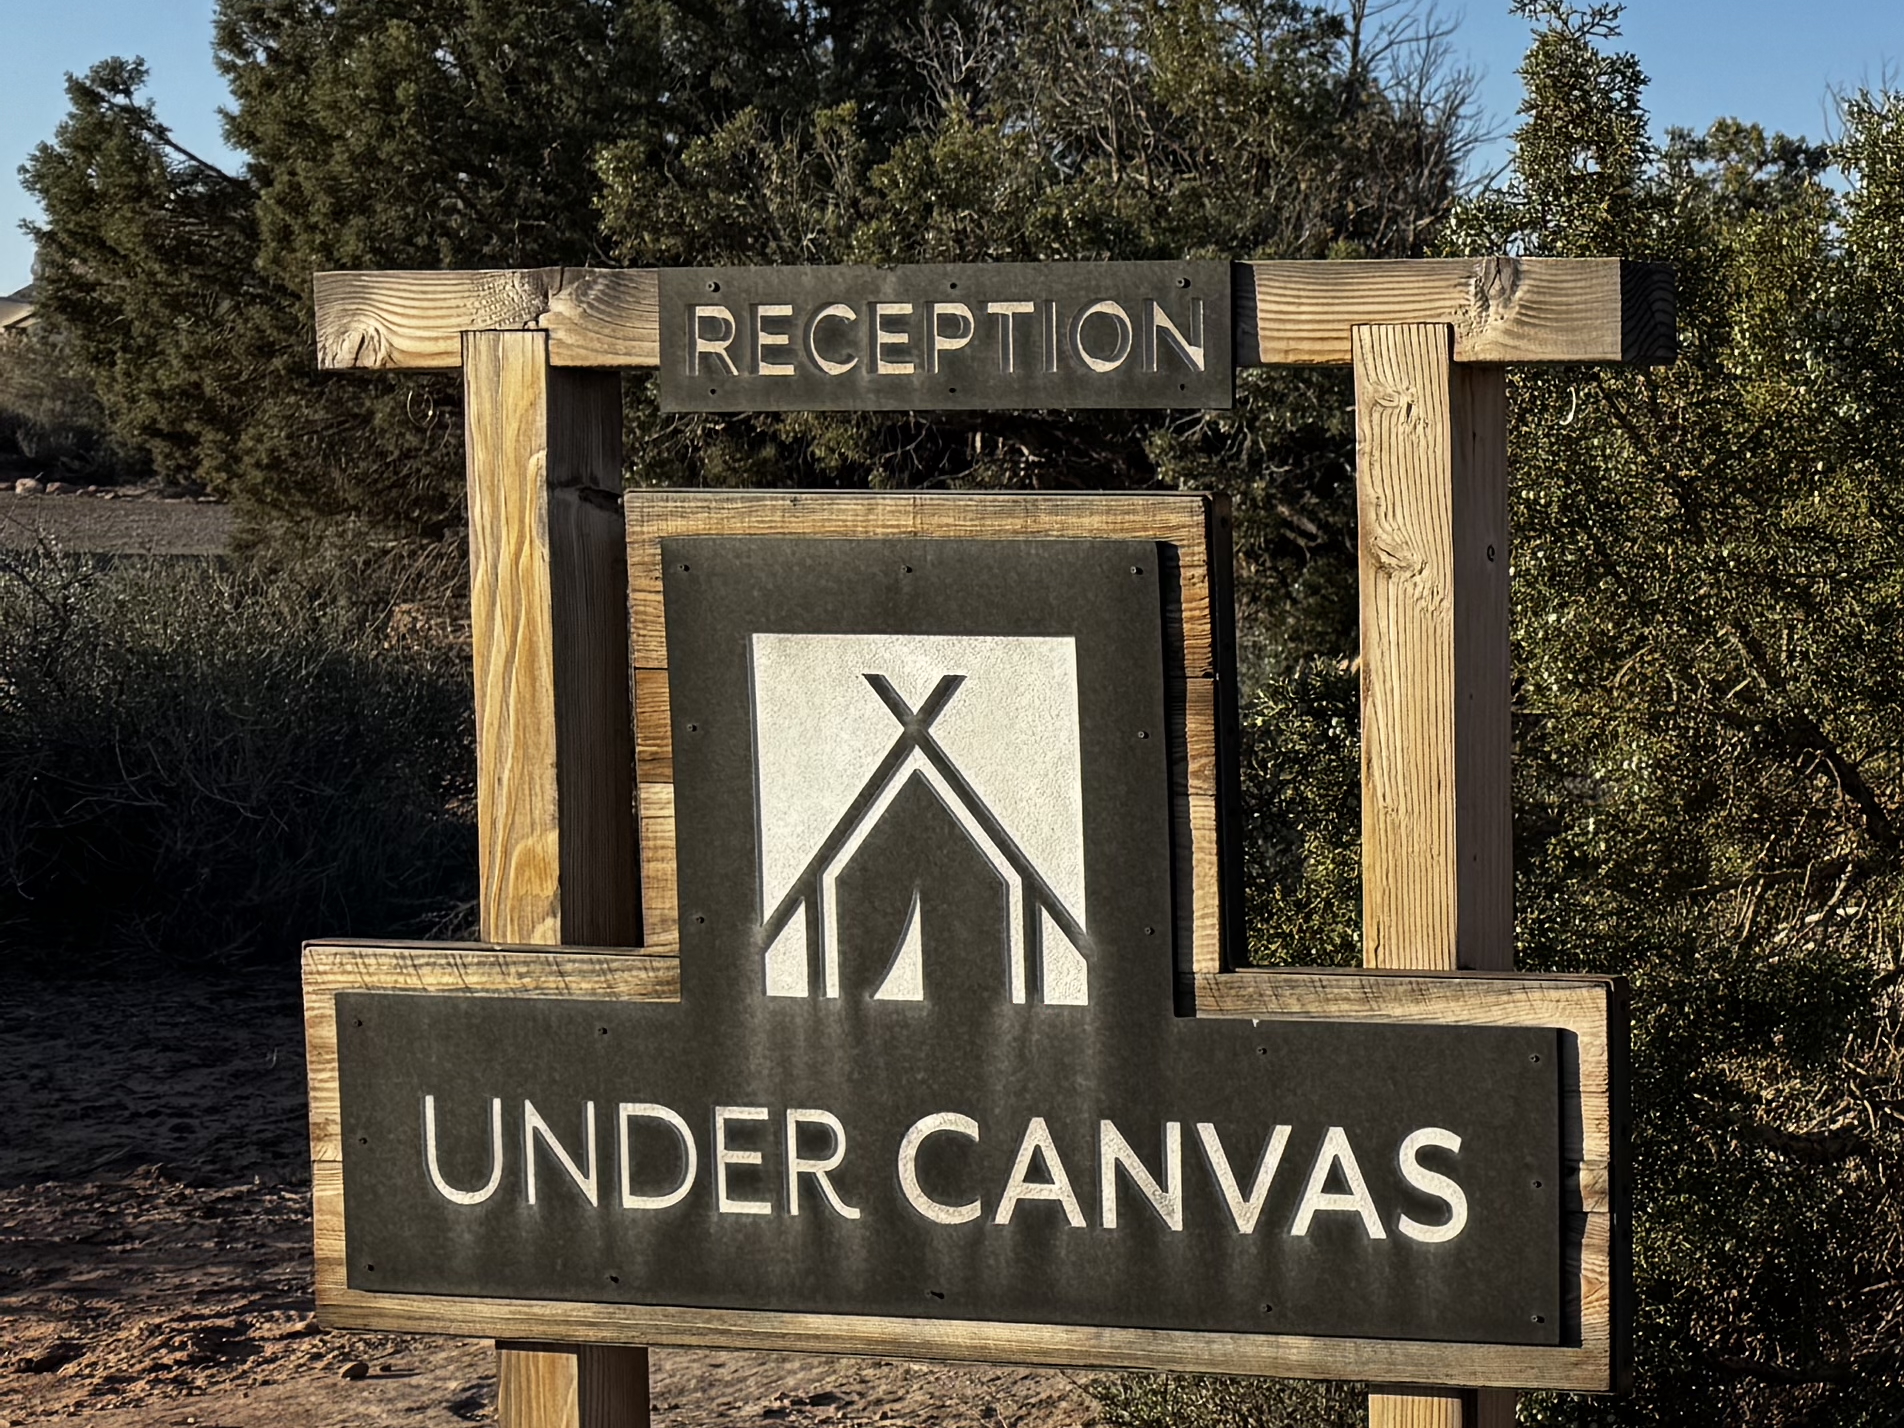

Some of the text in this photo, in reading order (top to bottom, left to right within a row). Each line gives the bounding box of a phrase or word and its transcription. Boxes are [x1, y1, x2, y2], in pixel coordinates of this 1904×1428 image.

[687, 299, 1205, 376] RECEPTION
[422, 1094, 1469, 1243] UNDER CANVAS
